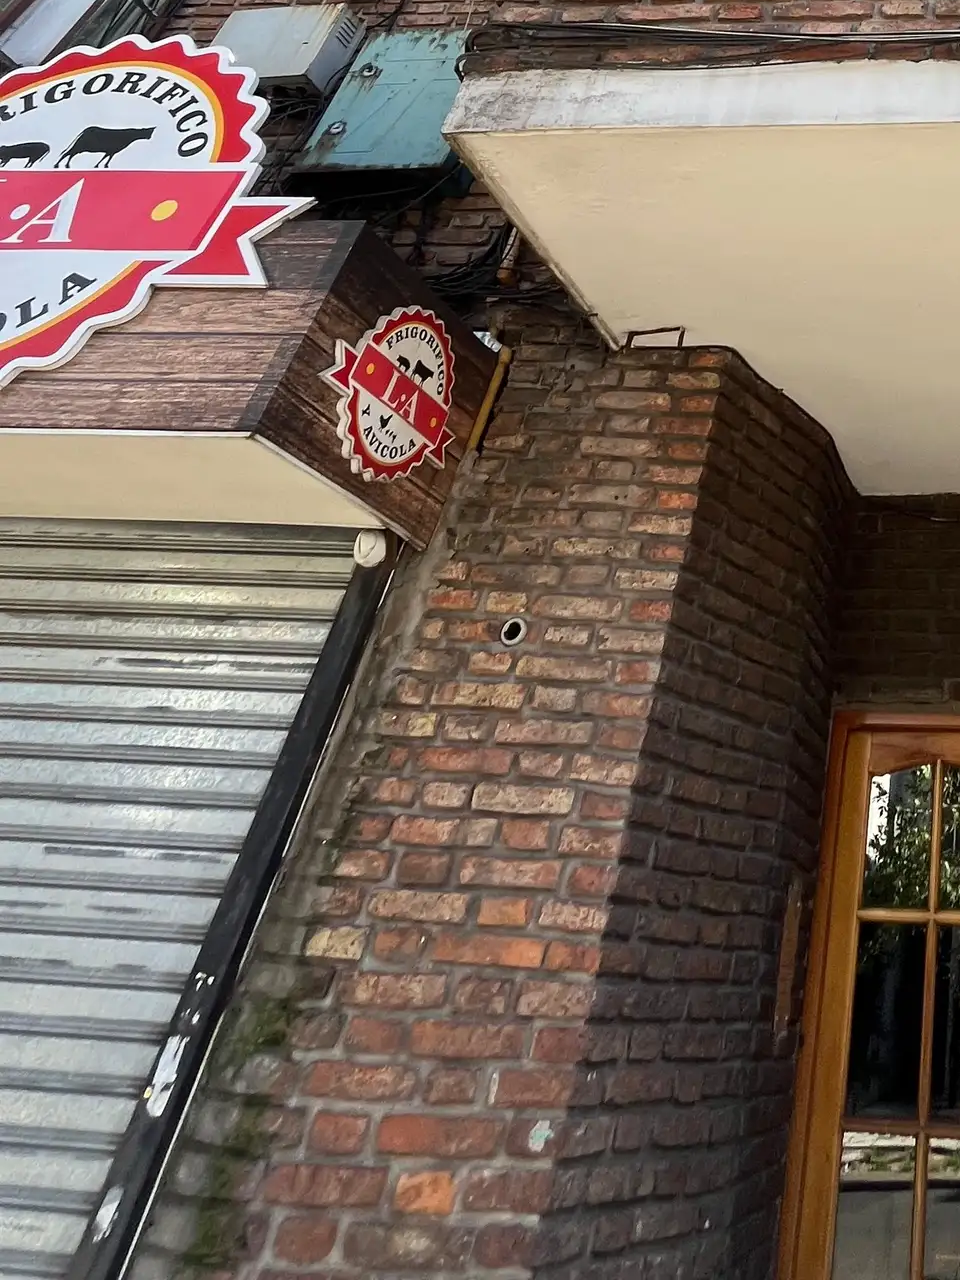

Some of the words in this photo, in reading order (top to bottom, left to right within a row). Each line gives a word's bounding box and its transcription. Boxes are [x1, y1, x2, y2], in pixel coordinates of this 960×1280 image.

[386, 326, 445, 396] FRIGORIFICO
[361, 403, 371, 417] Y
[363, 425, 417, 459] AVICOLA
